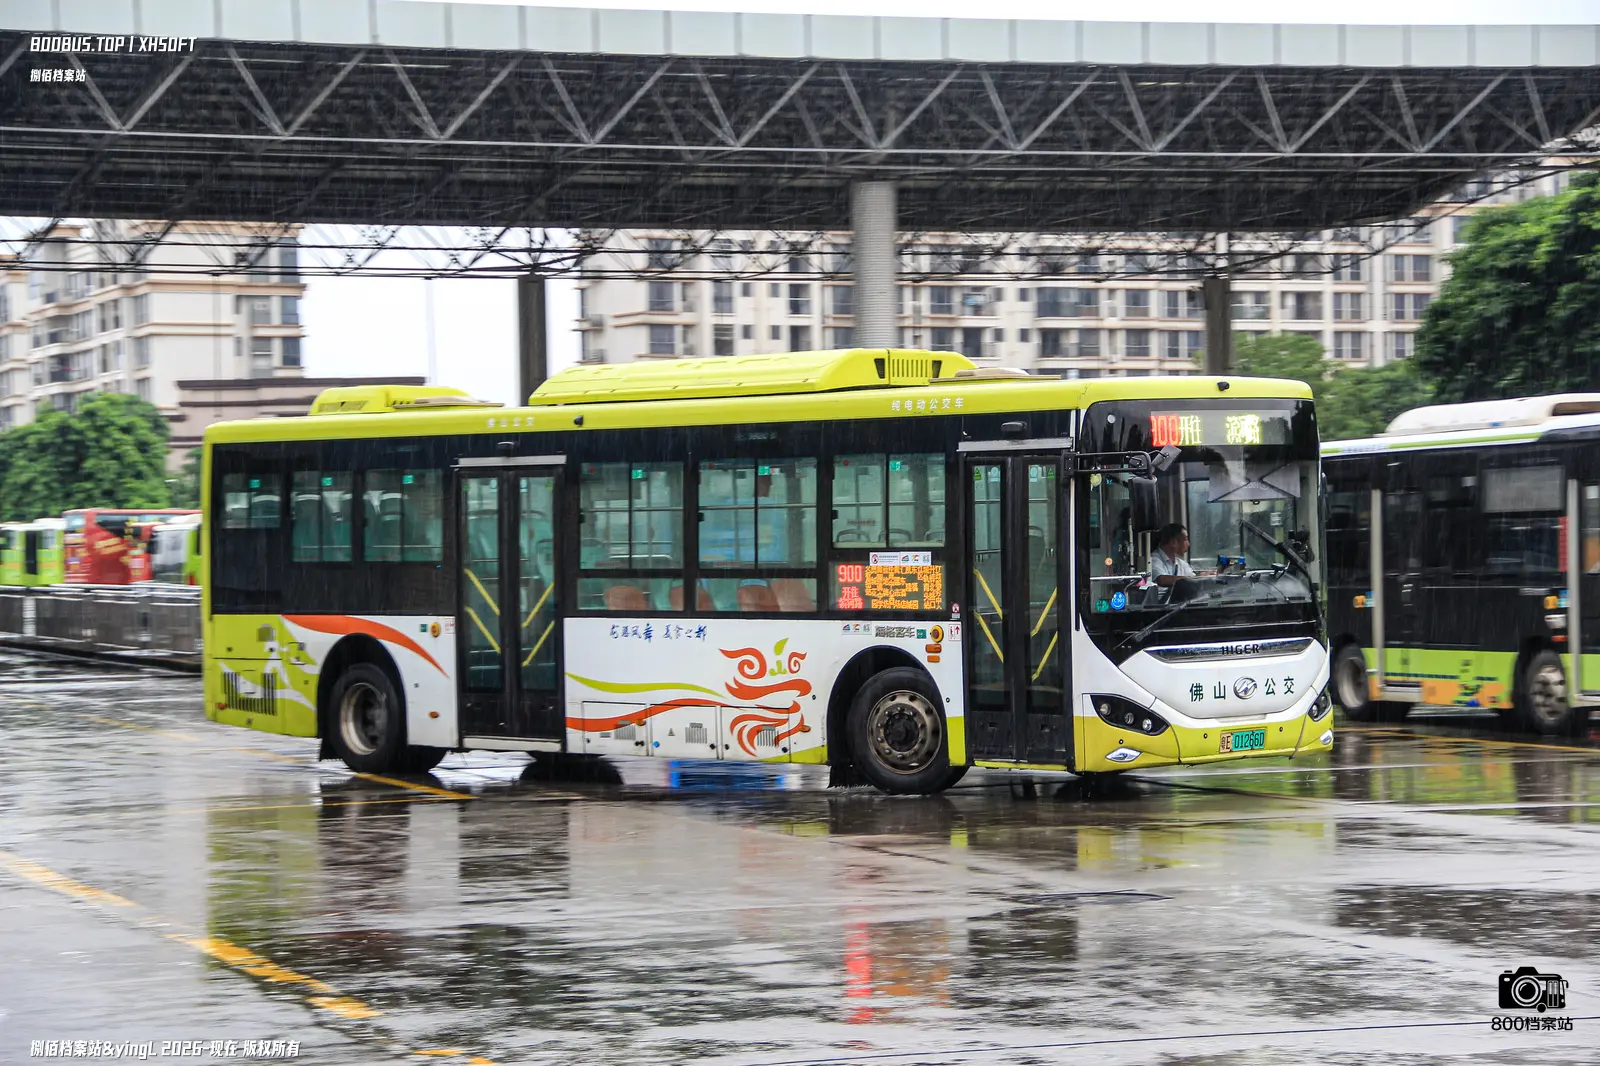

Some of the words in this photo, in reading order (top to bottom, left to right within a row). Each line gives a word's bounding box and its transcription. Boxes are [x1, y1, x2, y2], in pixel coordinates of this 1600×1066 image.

[891, 397, 964, 411] 纯电动公交车
[838, 564, 863, 583] 900
[1220, 643, 1260, 656] HIGER
[1189, 681, 1226, 702] 佛山
[1265, 676, 1294, 695] 公交
